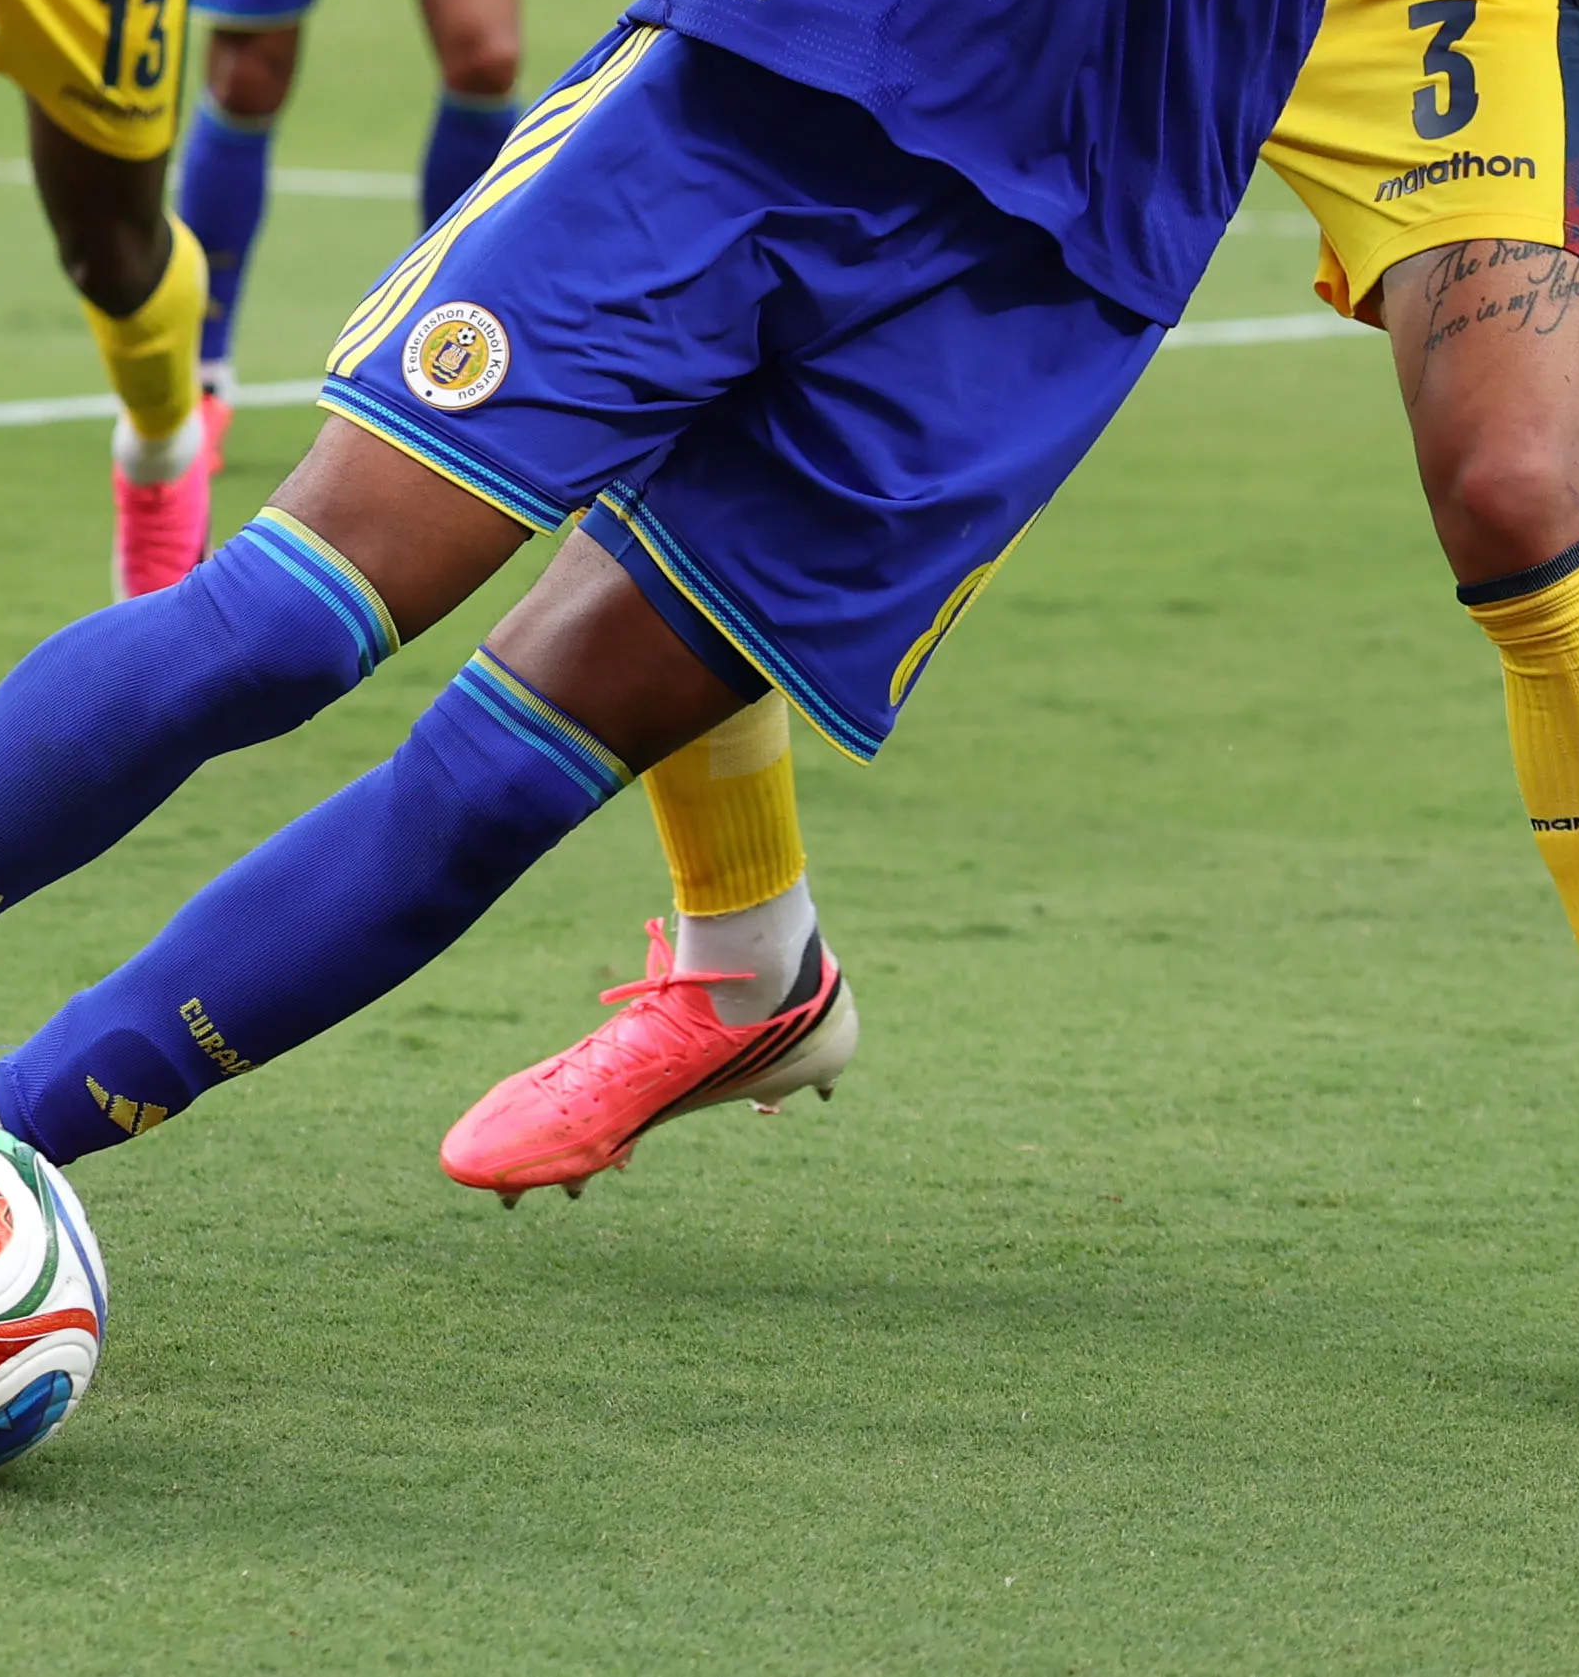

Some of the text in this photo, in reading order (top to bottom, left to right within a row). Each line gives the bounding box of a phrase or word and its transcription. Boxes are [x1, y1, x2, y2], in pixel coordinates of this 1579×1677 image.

[1373, 150, 1537, 203] marathon
[1425, 238, 1482, 302] The
[1476, 296, 1503, 321] in
[1506, 289, 1539, 334] my
[406, 308, 465, 374] Federashon
